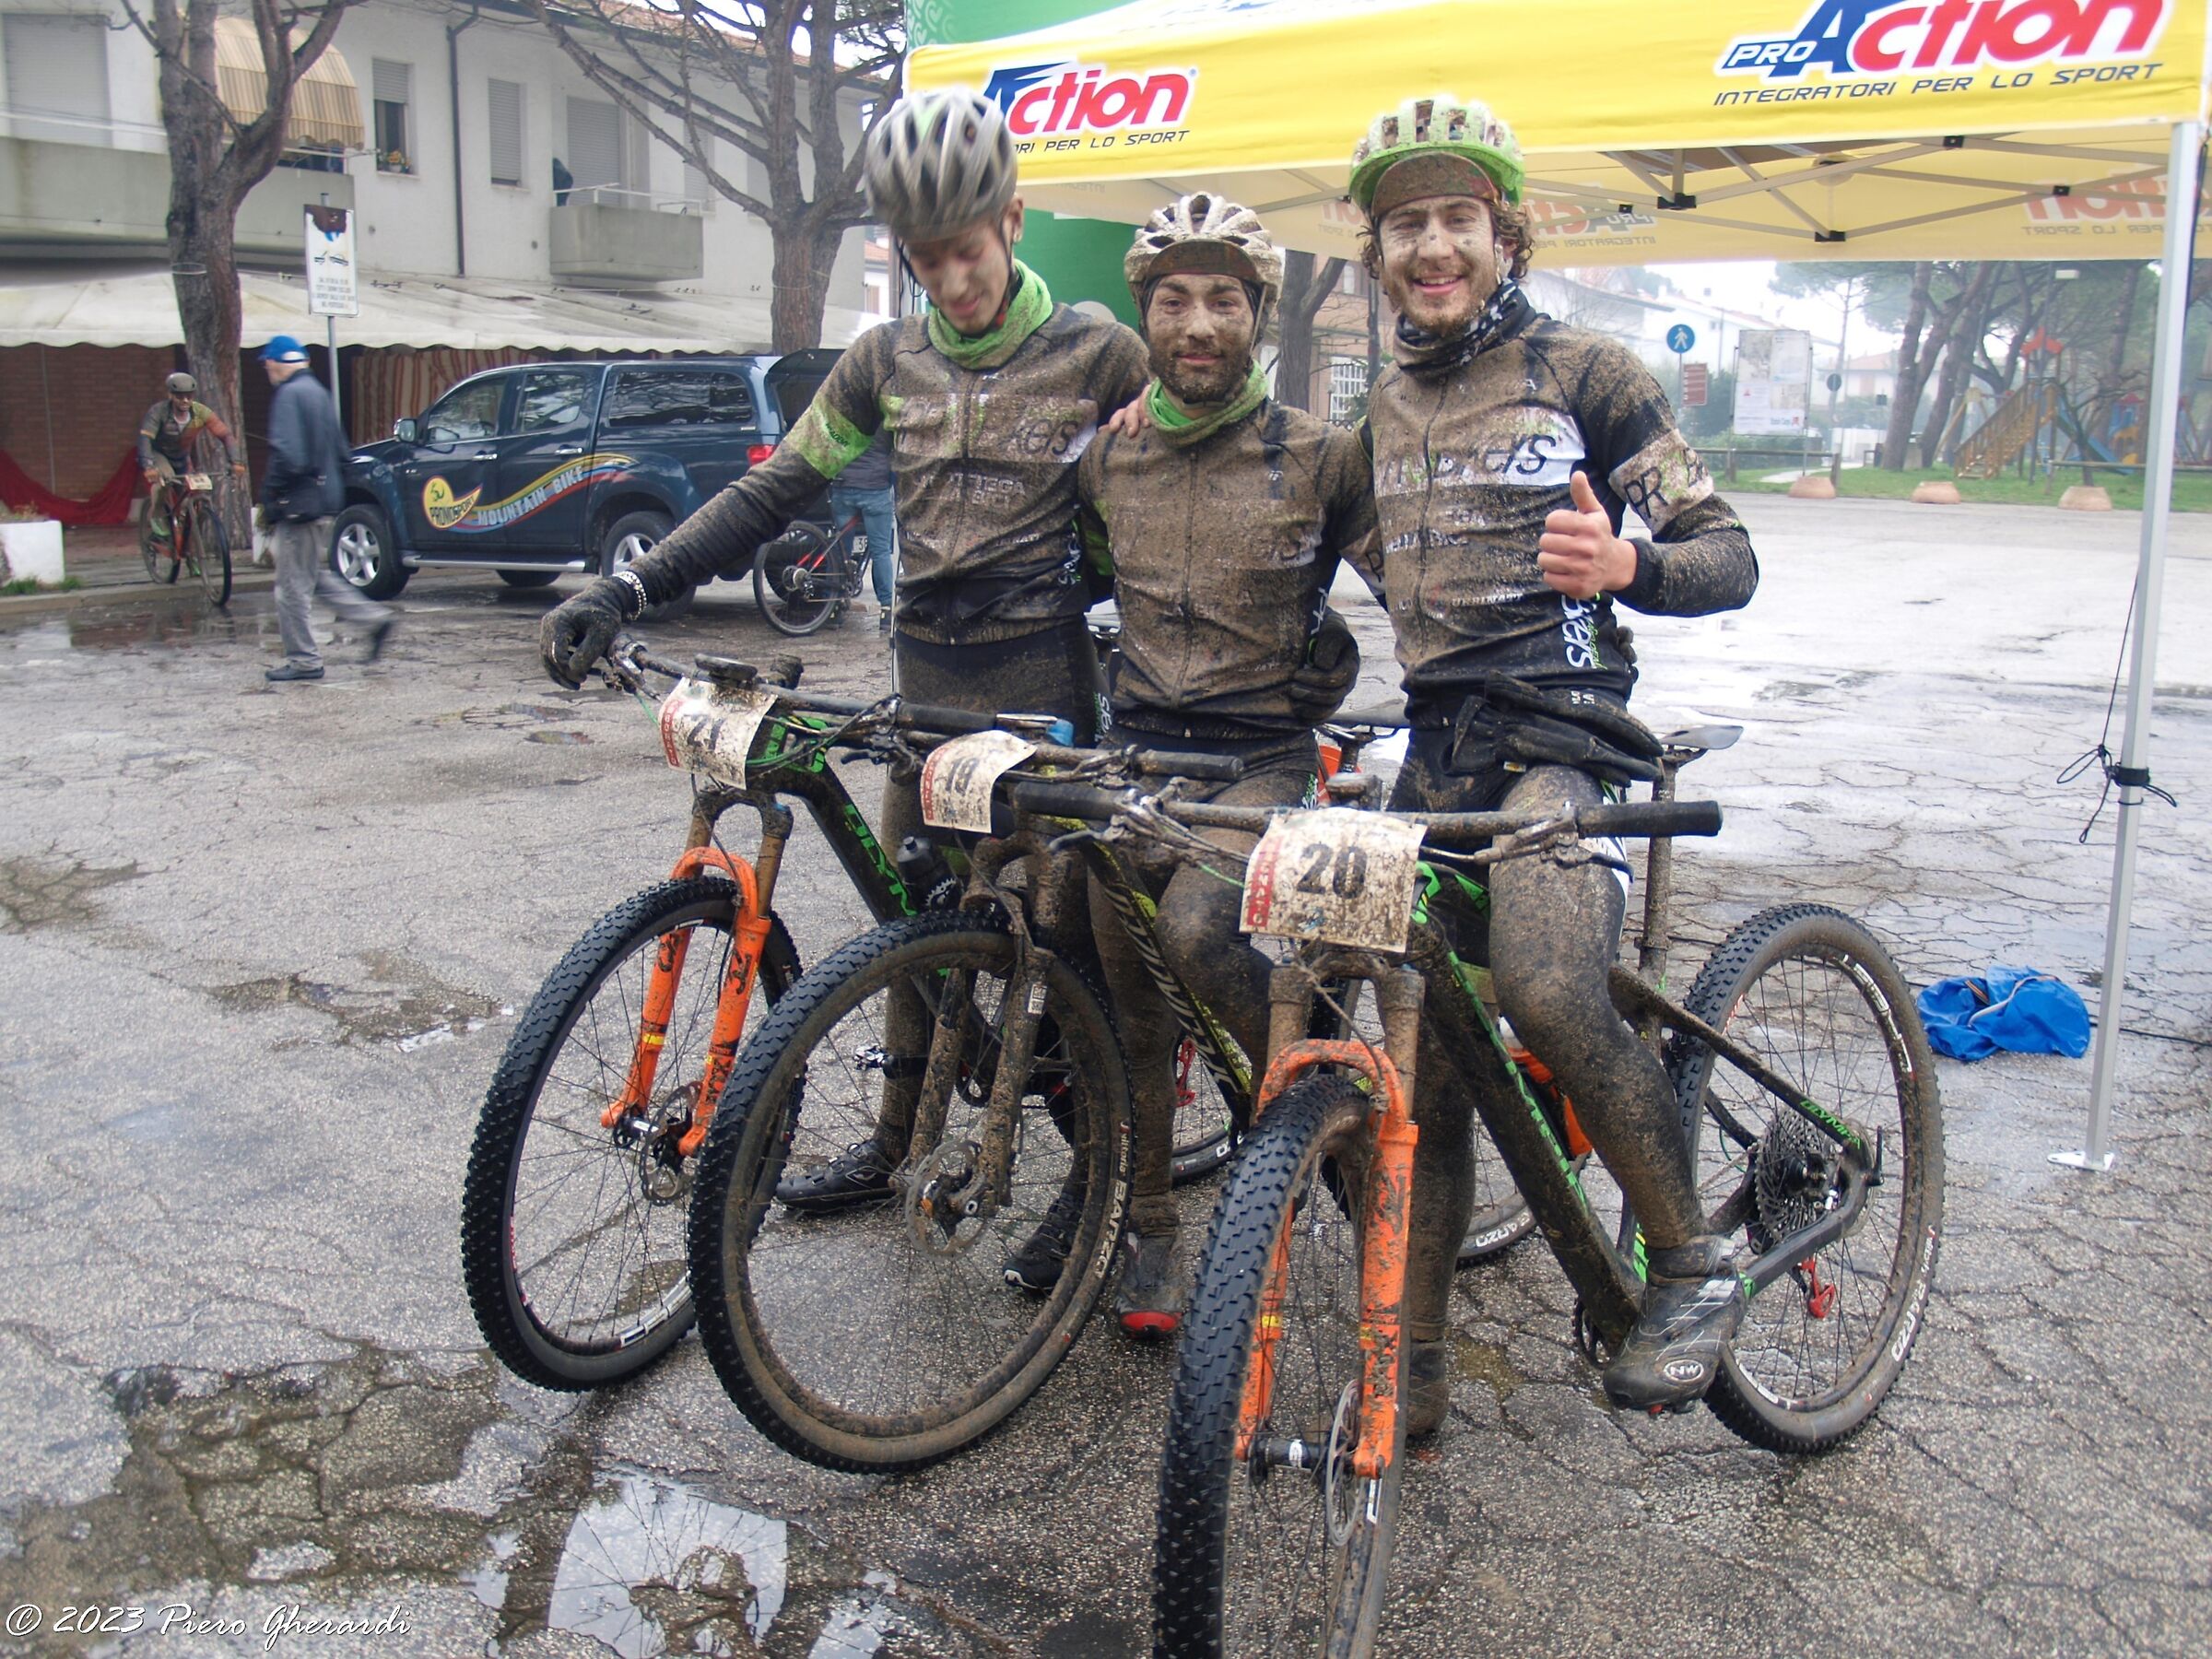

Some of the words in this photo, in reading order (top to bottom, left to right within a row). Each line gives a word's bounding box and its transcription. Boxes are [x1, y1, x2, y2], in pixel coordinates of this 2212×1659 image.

[1726, 43, 1815, 69] PRO
[1713, 81, 1898, 106] INTEGRATORI
[1911, 76, 1974, 96] PER
[1990, 73, 2032, 88] LO
[2050, 64, 2164, 85] SPORT
[1044, 139, 1080, 152] PER
[1089, 136, 1116, 148] LO
[1124, 130, 1191, 146] SPORT
[477, 487, 547, 526] MOUNTAIN
[553, 465, 584, 495] BIKE
[1296, 842, 1368, 899] 20
[1670, 1365, 1699, 1375] NW
